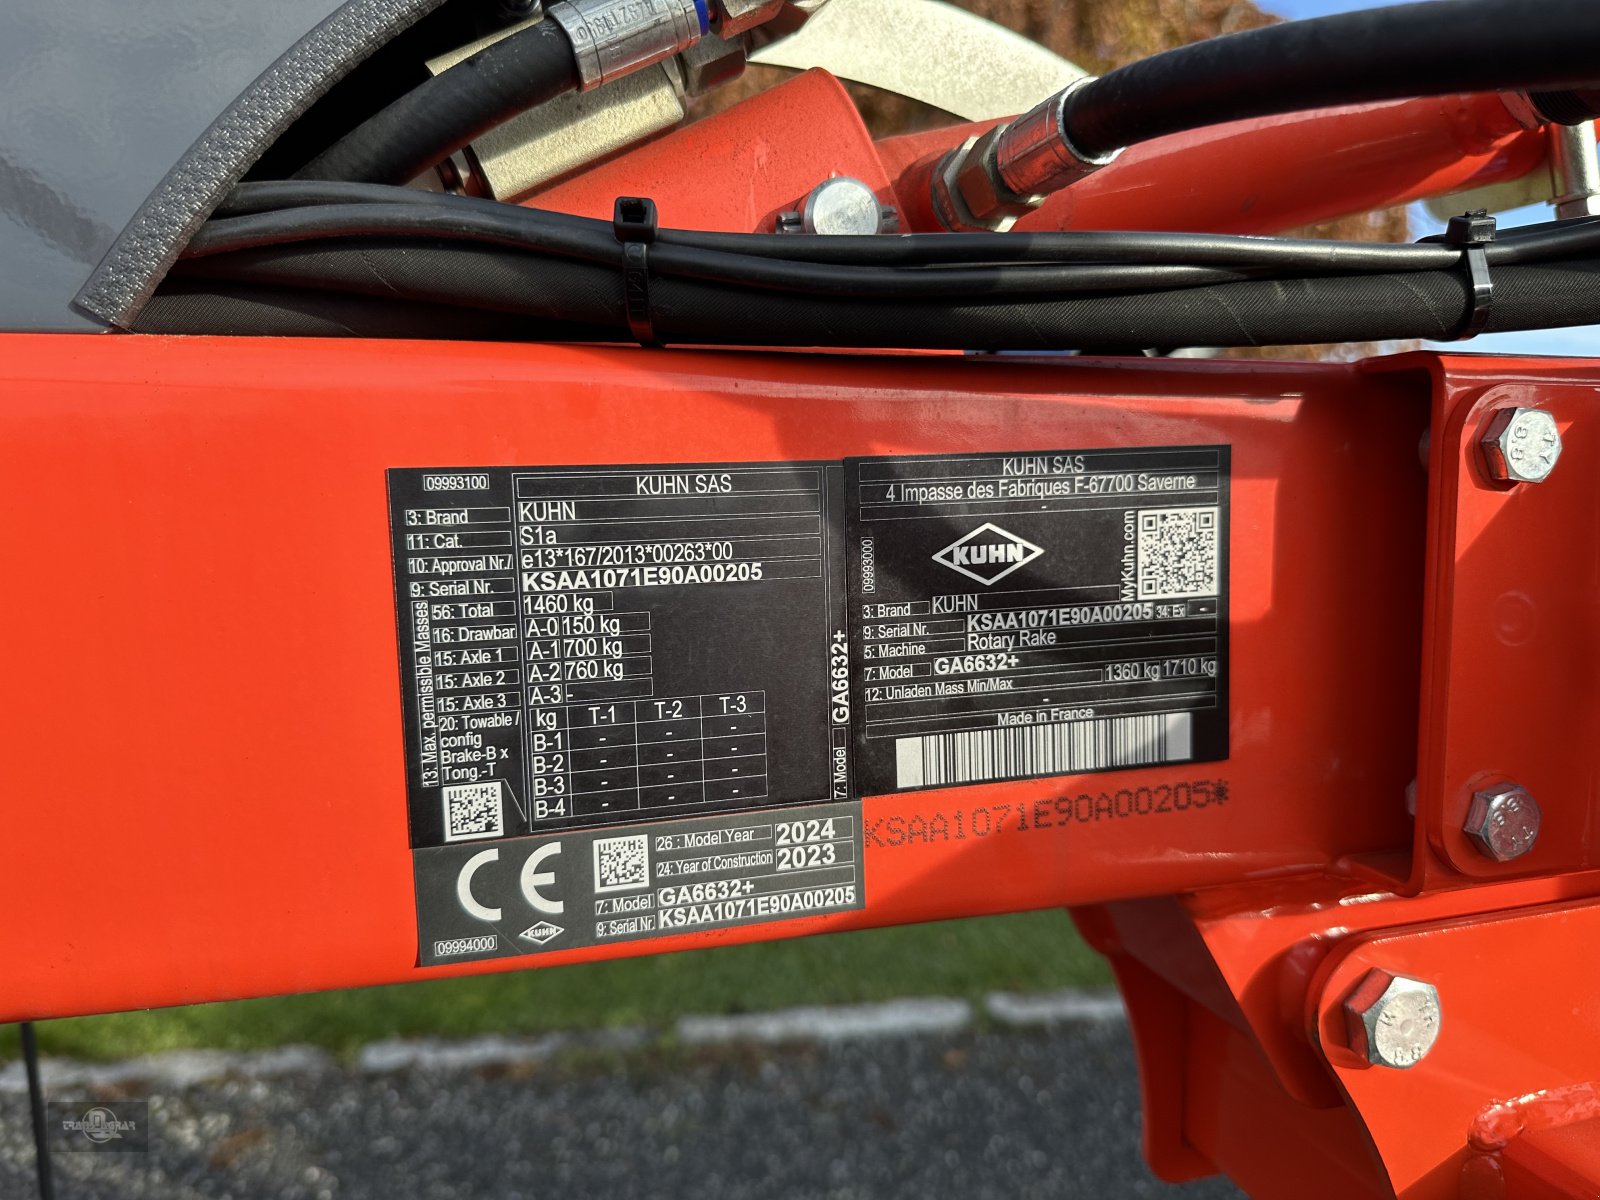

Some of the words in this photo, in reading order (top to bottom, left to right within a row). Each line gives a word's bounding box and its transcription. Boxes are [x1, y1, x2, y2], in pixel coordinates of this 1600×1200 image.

[1003, 456, 1048, 476] KUHN
[1052, 455, 1085, 474] SAS
[426, 476, 487, 490] 09993100
[636, 475, 689, 495] KUHN
[695, 473, 732, 493] SAS
[886, 484, 895, 501] 4
[901, 482, 963, 505] Impasse
[968, 481, 994, 498] des
[999, 478, 1070, 500] Fabriques
[1074, 473, 1133, 494] F-67700
[1137, 472, 1196, 491] Saverne
[408, 511, 421, 525] 3:
[427, 509, 468, 524] Brand
[520, 501, 576, 522] KUHN
[408, 535, 430, 549] 11:
[434, 533, 463, 548] Cat.
[520, 526, 557, 545] S1a
[952, 543, 1024, 566] KUHN
[1121, 510, 1137, 602] MyKuhn.com
[409, 558, 429, 574] 10:
[432, 556, 486, 575] Approval
[489, 554, 513, 570] Nr./
[862, 539, 873, 591] 09993000
[523, 562, 763, 592] KSAA1071E90A00205
[411, 583, 425, 597] 9:
[429, 580, 469, 595] Serial
[474, 579, 494, 594] Nr.
[432, 605, 455, 620] 56:
[458, 602, 494, 618] Total
[524, 594, 568, 615] 1460
[573, 593, 594, 615] kg
[863, 606, 874, 619] 3:
[878, 602, 910, 618] Brand
[933, 594, 978, 614] KUHN
[1156, 606, 1170, 618] 34:
[1172, 604, 1185, 617] Ex
[415, 601, 431, 652] Masses
[563, 616, 594, 635] 150
[600, 614, 620, 636] kg
[967, 602, 1153, 632] KSAA1071E90A00205
[433, 628, 455, 643] 16:
[458, 625, 515, 641] Drawbar
[527, 618, 558, 638] A-0
[863, 626, 875, 639] 9:
[878, 623, 910, 638] Serial
[913, 622, 929, 636] Nr.
[564, 638, 597, 657] 700
[602, 636, 623, 658] kg
[968, 633, 1015, 651] Rotary
[1019, 629, 1056, 646] Rake
[434, 651, 456, 666] 15:
[460, 649, 491, 665] Axle
[496, 649, 502, 663] 1
[529, 640, 560, 660] A-1
[864, 646, 875, 659] 5:
[878, 642, 926, 658] Machine
[529, 663, 561, 682] A-2
[565, 661, 599, 680] 760
[603, 659, 624, 681] kg
[864, 668, 876, 681] 7:
[879, 664, 913, 679] Model
[934, 653, 1019, 675] GA6632+
[1105, 664, 1141, 681] 1360
[1143, 662, 1161, 681] kg
[1163, 659, 1195, 677] 1710
[1200, 658, 1216, 677] kg
[436, 674, 458, 689] 15:
[462, 672, 492, 688] Axle
[496, 671, 506, 686] 2
[831, 629, 850, 723] GA6632+
[417, 656, 438, 728] permissible
[530, 685, 562, 705] A-3
[865, 688, 883, 701] 12:
[886, 684, 932, 700] Unladen
[935, 682, 964, 696] Mass
[967, 678, 1013, 693] Min/Max
[437, 697, 459, 712] 15:
[463, 695, 494, 710] Axle
[497, 694, 507, 708] 3
[654, 700, 682, 719] T-2
[719, 695, 747, 714] T-3
[439, 716, 459, 731] 20:
[461, 713, 513, 731] Towable
[536, 709, 557, 730] kg
[589, 706, 616, 724] T-1
[997, 711, 1033, 726] Made
[1036, 709, 1047, 723] in
[1051, 707, 1094, 722] France
[421, 732, 437, 763] Max.
[441, 732, 482, 749] config
[533, 733, 562, 752] B-1
[442, 746, 496, 763] Brake-B
[500, 747, 509, 760] x
[442, 762, 496, 782] Tong.-T
[534, 755, 564, 774] B-2
[834, 747, 846, 783] Model
[423, 767, 438, 785] 13:
[535, 778, 565, 796] B-3
[834, 786, 846, 798] 7:
[535, 799, 565, 818] B-4
[685, 831, 721, 847] Model
[725, 829, 754, 843] Year
[776, 819, 835, 844] 2024
[658, 862, 674, 876] 24:
[676, 859, 699, 874] Year
[701, 858, 711, 871] of
[714, 851, 773, 869] Construction
[777, 843, 836, 870] 2023
[659, 879, 754, 906] GA6632+
[596, 901, 608, 914] 7:
[612, 896, 651, 912] Model
[659, 886, 855, 929] KSAA1071E90A00205
[528, 928, 557, 937] KUHN
[597, 922, 607, 937] 9:
[610, 919, 637, 935] Serial
[640, 917, 655, 932] Nr.
[437, 937, 494, 954] 09994000
